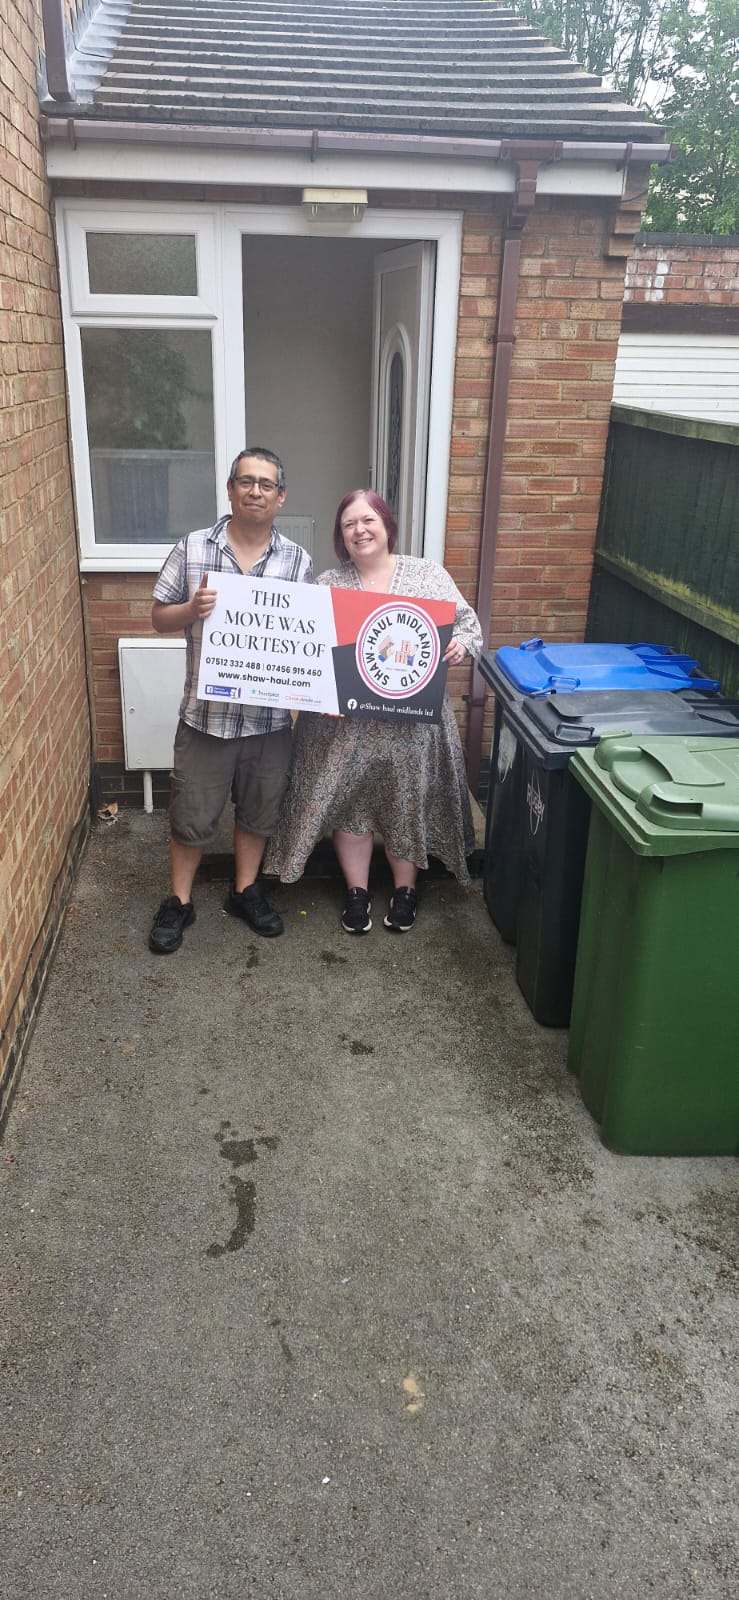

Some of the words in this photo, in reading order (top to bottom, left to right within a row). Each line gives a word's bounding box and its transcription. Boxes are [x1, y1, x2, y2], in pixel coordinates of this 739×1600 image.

[252, 589, 291, 609] THIS
[224, 609, 275, 630] MOVE
[278, 616, 316, 635] WAS
[209, 630, 300, 655] COURTESY
[303, 641, 326, 658] OF
[396, 613, 431, 669] MIDLANDS
[205, 657, 228, 667] 07512
[229, 659, 244, 668] 332
[245, 661, 261, 670] 488
[266, 664, 291, 673] 07456
[292, 666, 305, 675] 915
[306, 668, 322, 677] 460
[218, 671, 311, 688] www.shaw-haul.com
[400, 669, 421, 687] LTD
[382, 704, 396, 713] haul
[396, 706, 423, 716] midlands
